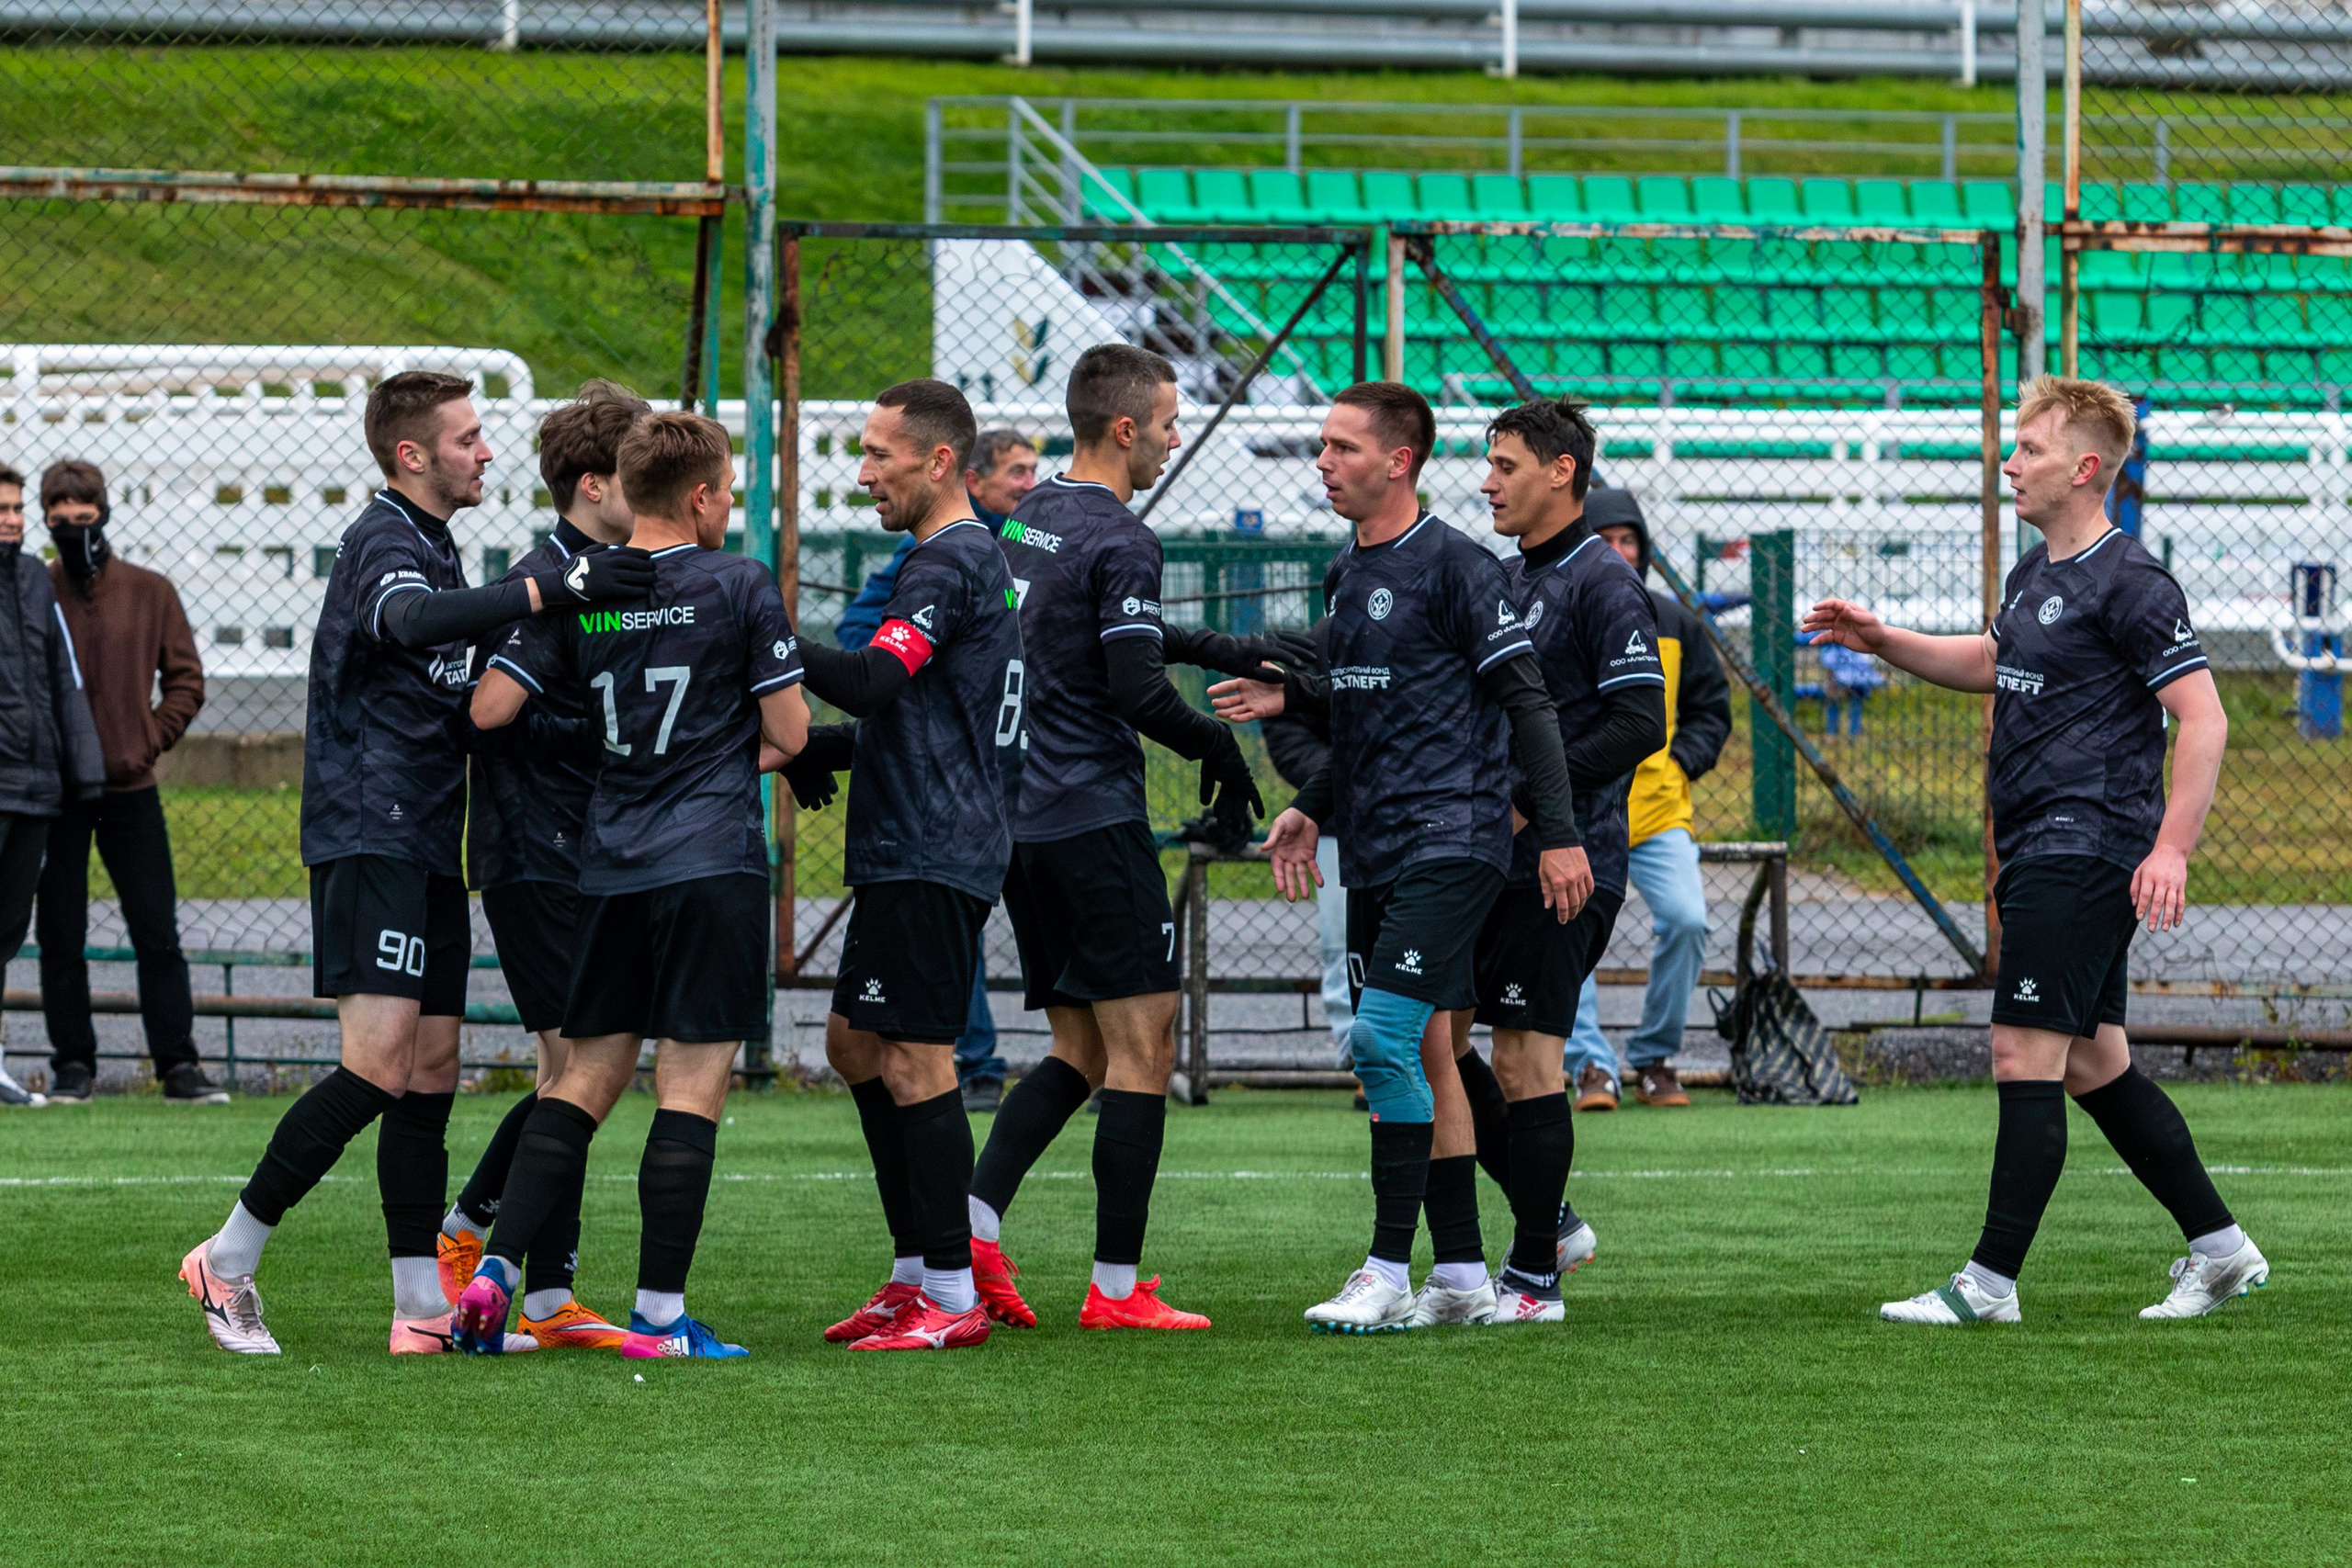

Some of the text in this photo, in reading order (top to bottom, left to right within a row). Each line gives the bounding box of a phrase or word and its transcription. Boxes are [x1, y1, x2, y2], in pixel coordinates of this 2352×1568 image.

[1001, 518, 1063, 554] VINSERVICE
[879, 635, 908, 653] KELME
[1331, 674, 1391, 691] ATNEFT
[591, 666, 691, 757] 17
[995, 659, 1028, 750] 8
[1161, 922, 1175, 962] 7
[376, 929, 425, 977] 90
[1395, 962, 1423, 976] KELME
[859, 994, 887, 1003] KELME
[1499, 997, 1527, 1007] KELME
[2013, 993, 2041, 1002] KELME
